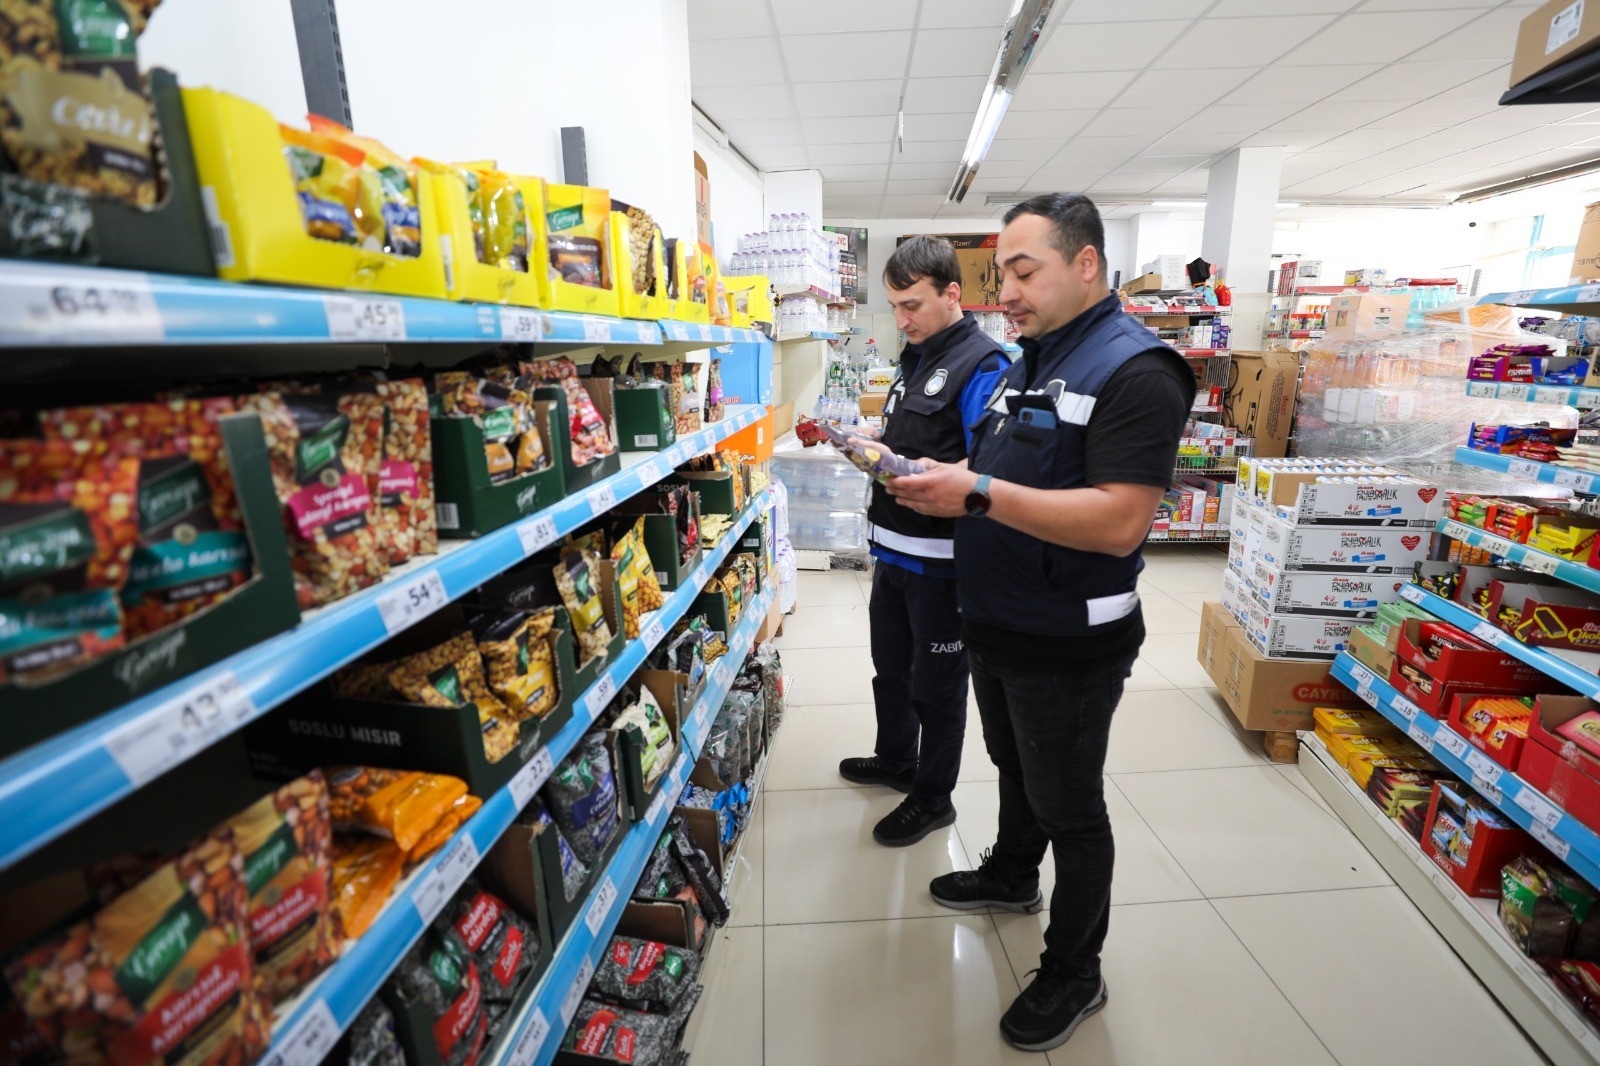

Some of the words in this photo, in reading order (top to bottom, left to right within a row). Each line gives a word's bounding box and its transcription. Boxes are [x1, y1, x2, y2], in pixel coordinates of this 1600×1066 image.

[836, 236, 847, 246] JVC
[52, 288, 104, 315] 64
[363, 304, 388, 325] 45
[408, 583, 430, 608] 54
[289, 719, 345, 739] SOSLU
